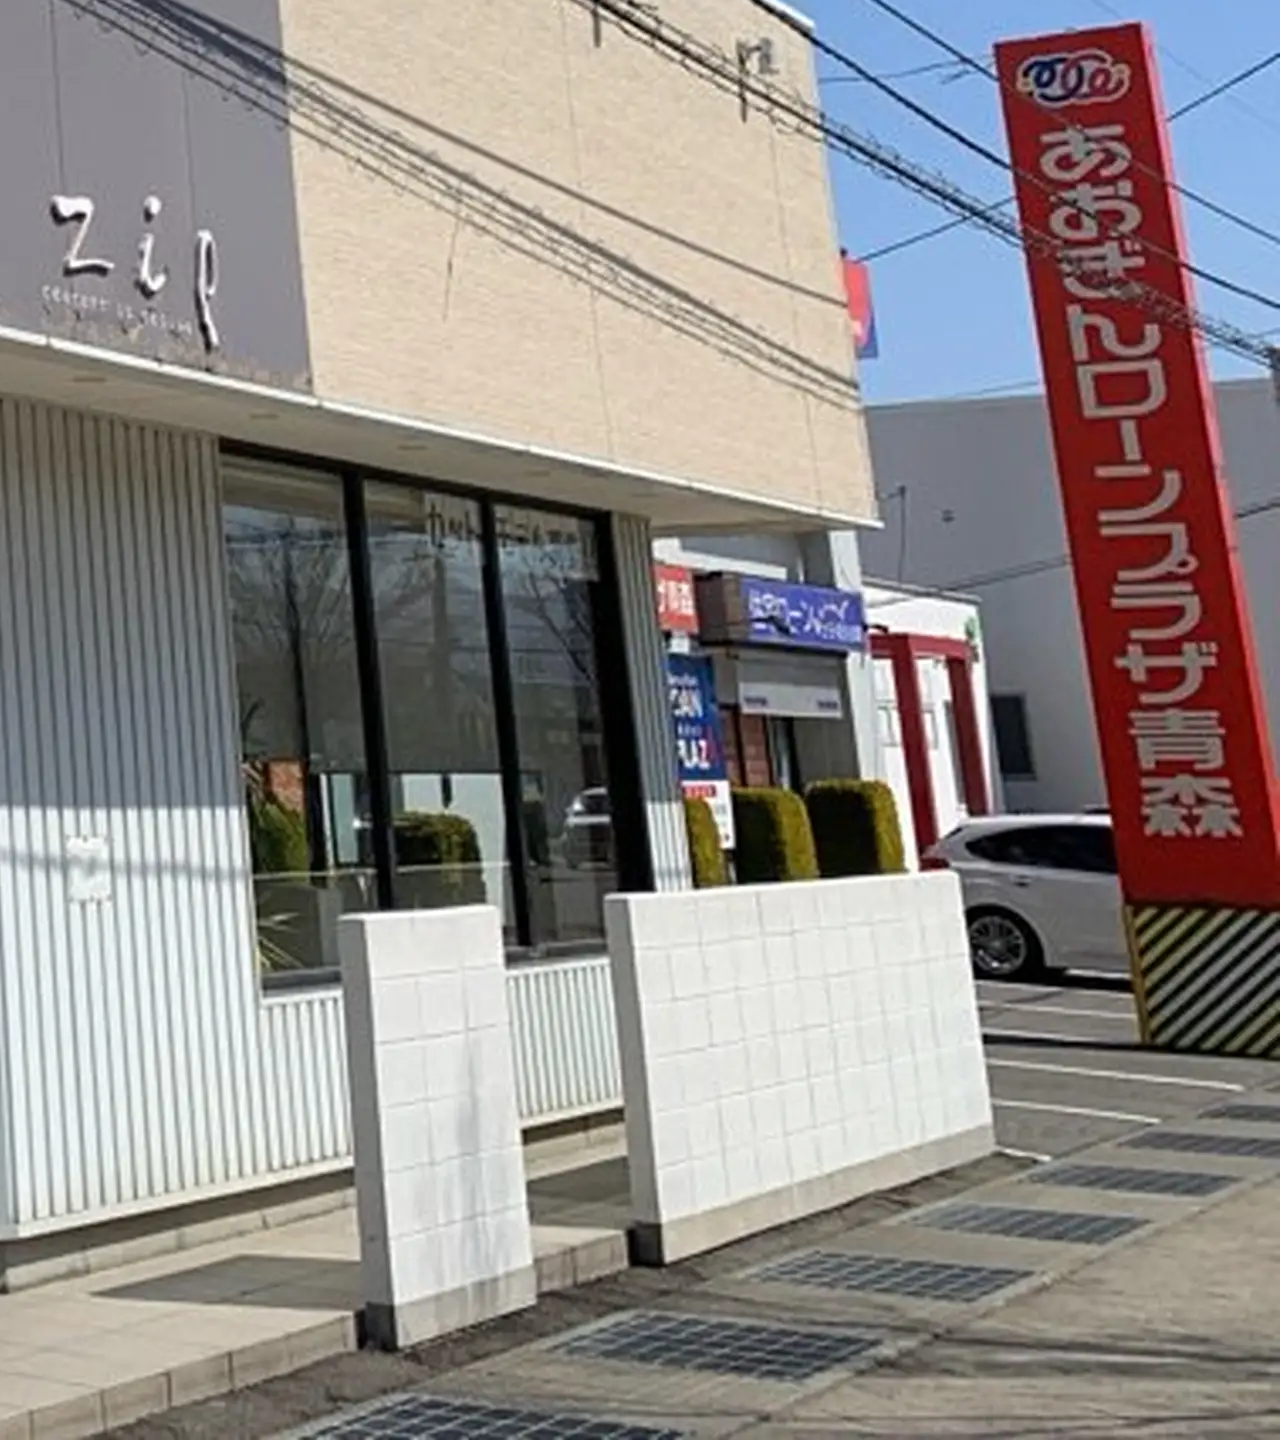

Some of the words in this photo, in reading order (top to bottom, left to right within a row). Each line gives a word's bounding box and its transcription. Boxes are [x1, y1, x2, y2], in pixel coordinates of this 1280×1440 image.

[50, 194, 219, 348] zip
[1039, 124, 1244, 838] あおぎんローンプラザ青森
